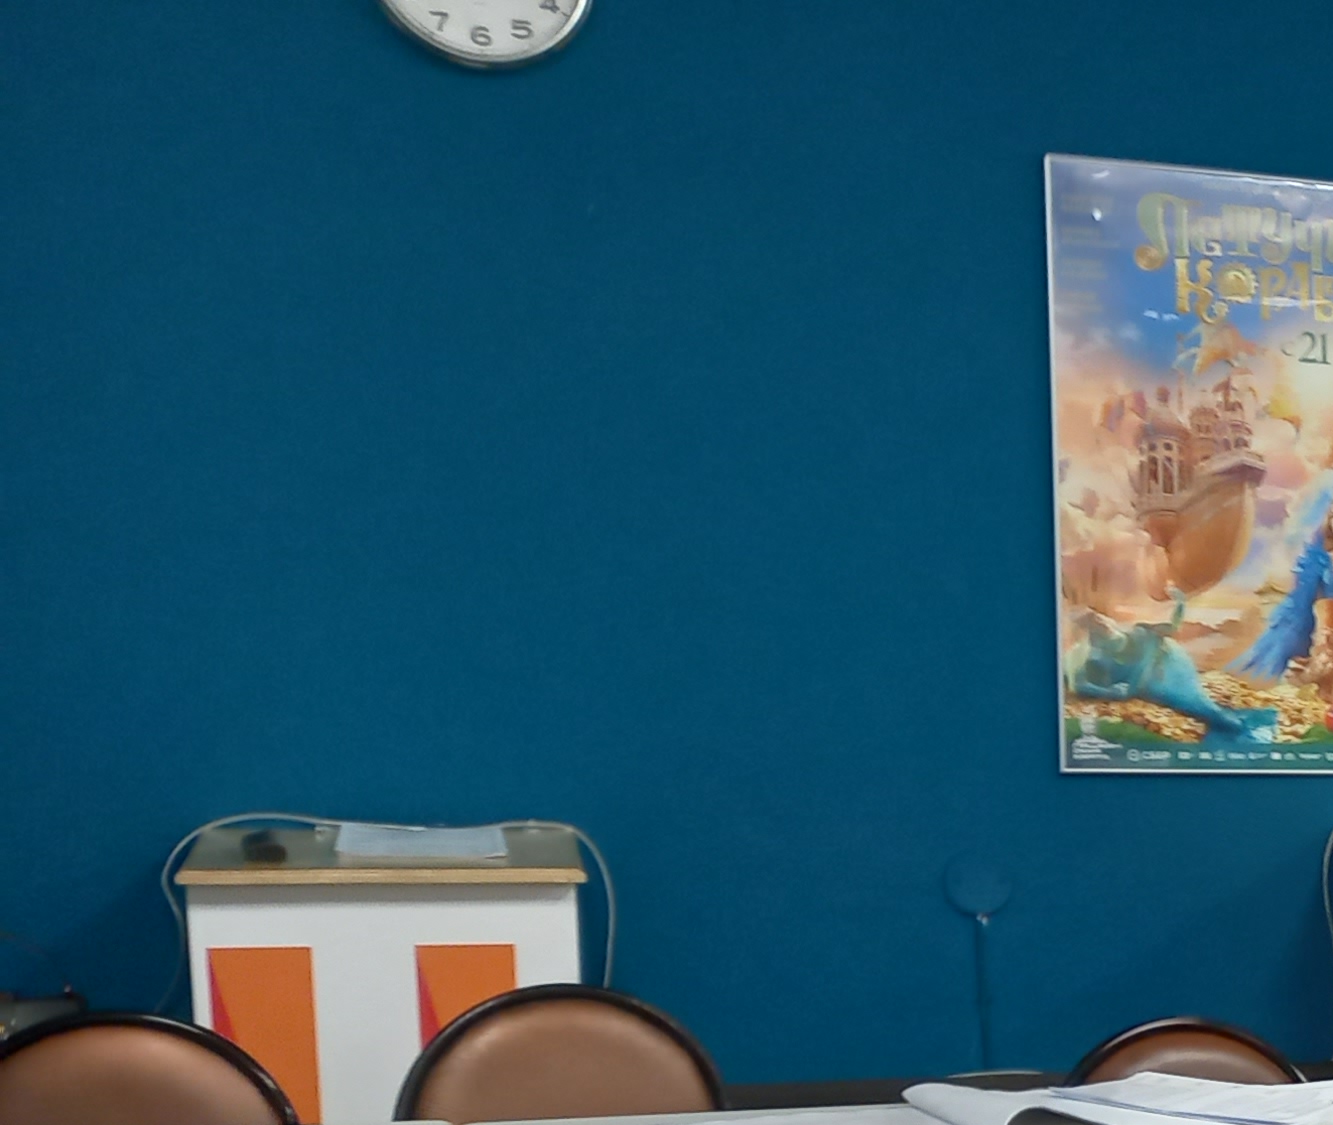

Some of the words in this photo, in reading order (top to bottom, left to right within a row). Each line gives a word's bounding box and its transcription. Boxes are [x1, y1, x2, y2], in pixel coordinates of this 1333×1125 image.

[428, 10, 449, 32] 7
[510, 19, 533, 40] 5
[470, 26, 493, 47] 6
[1297, 331, 1332, 366] 21
